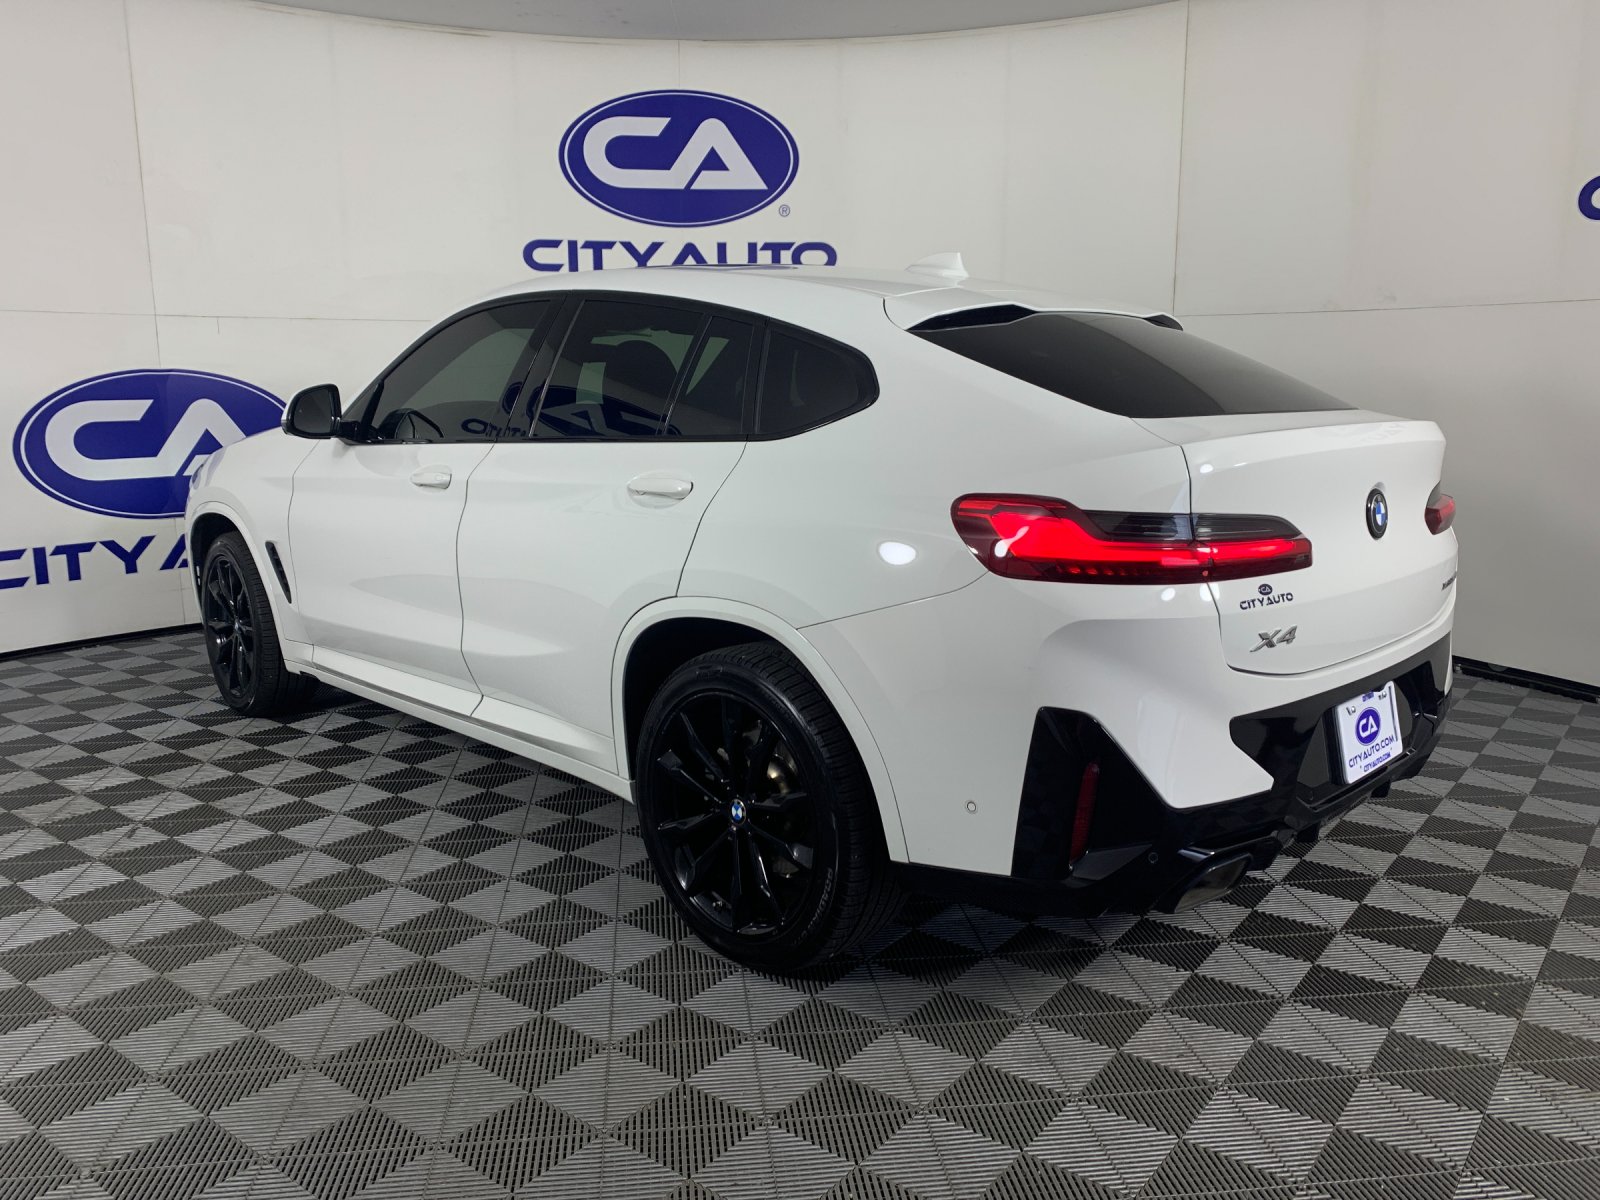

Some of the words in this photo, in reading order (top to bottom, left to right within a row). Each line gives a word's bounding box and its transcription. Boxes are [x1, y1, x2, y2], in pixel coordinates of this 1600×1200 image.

[583, 115, 768, 190] CA
[1250, 625, 1298, 653] X4
[1358, 715, 1378, 738] CA
